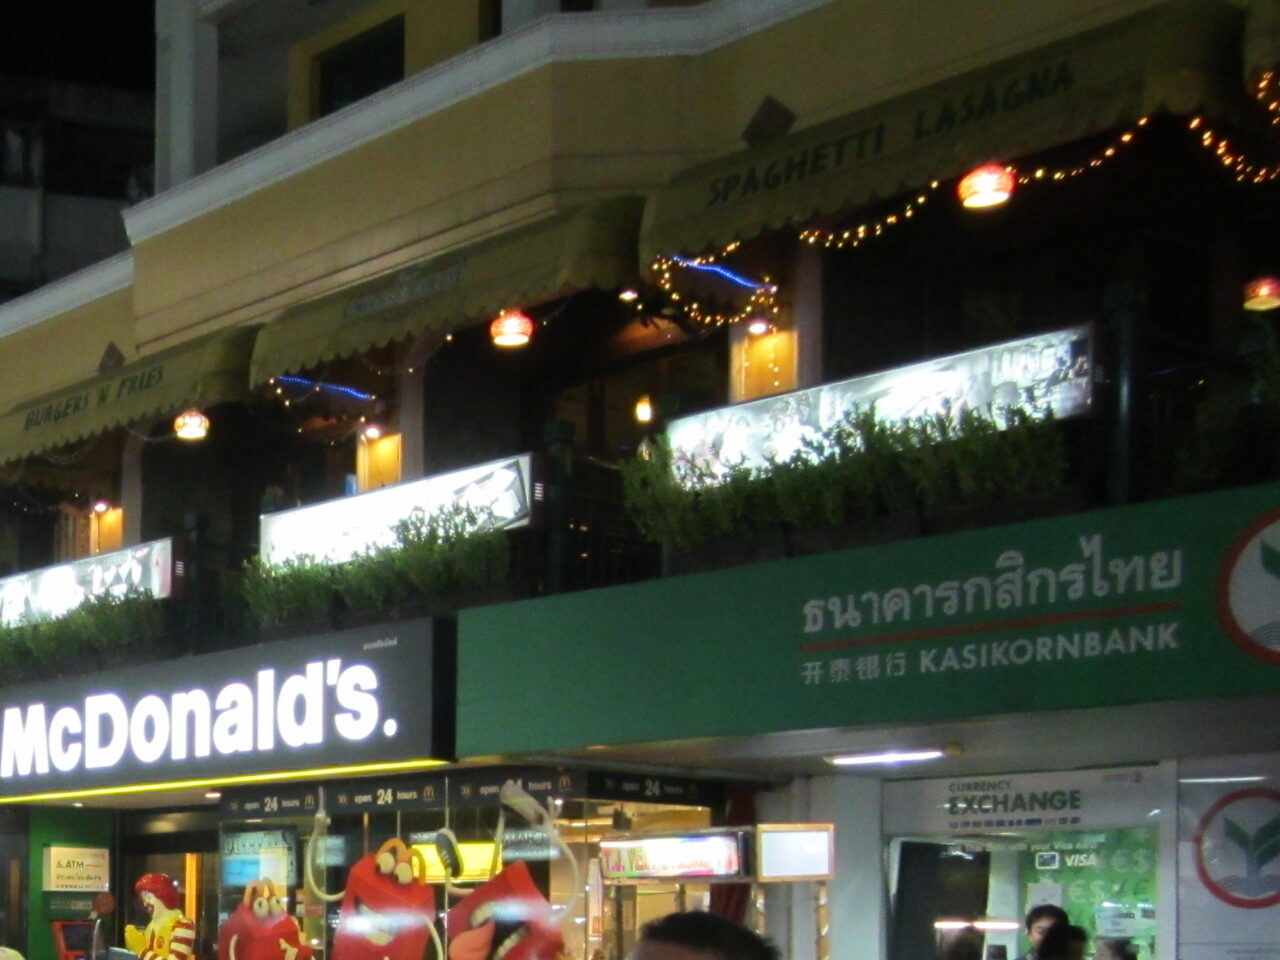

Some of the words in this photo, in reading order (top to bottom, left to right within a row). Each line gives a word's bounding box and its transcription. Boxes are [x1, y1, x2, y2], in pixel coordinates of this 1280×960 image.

[708, 122, 887, 207] SPAGHETTI
[914, 60, 1074, 143] LASAGNA
[802, 534, 1183, 634] ธนาคารกสิกรไทย
[920, 622, 1180, 675] KASIKORNBANK
[948, 780, 1012, 793] CURRENCY
[264, 797, 278, 812] 24
[376, 788, 393, 805] 24
[948, 789, 1081, 816] EXCHANGE
[66, 860, 84, 869] ATM
[1065, 853, 1097, 867] VISA
